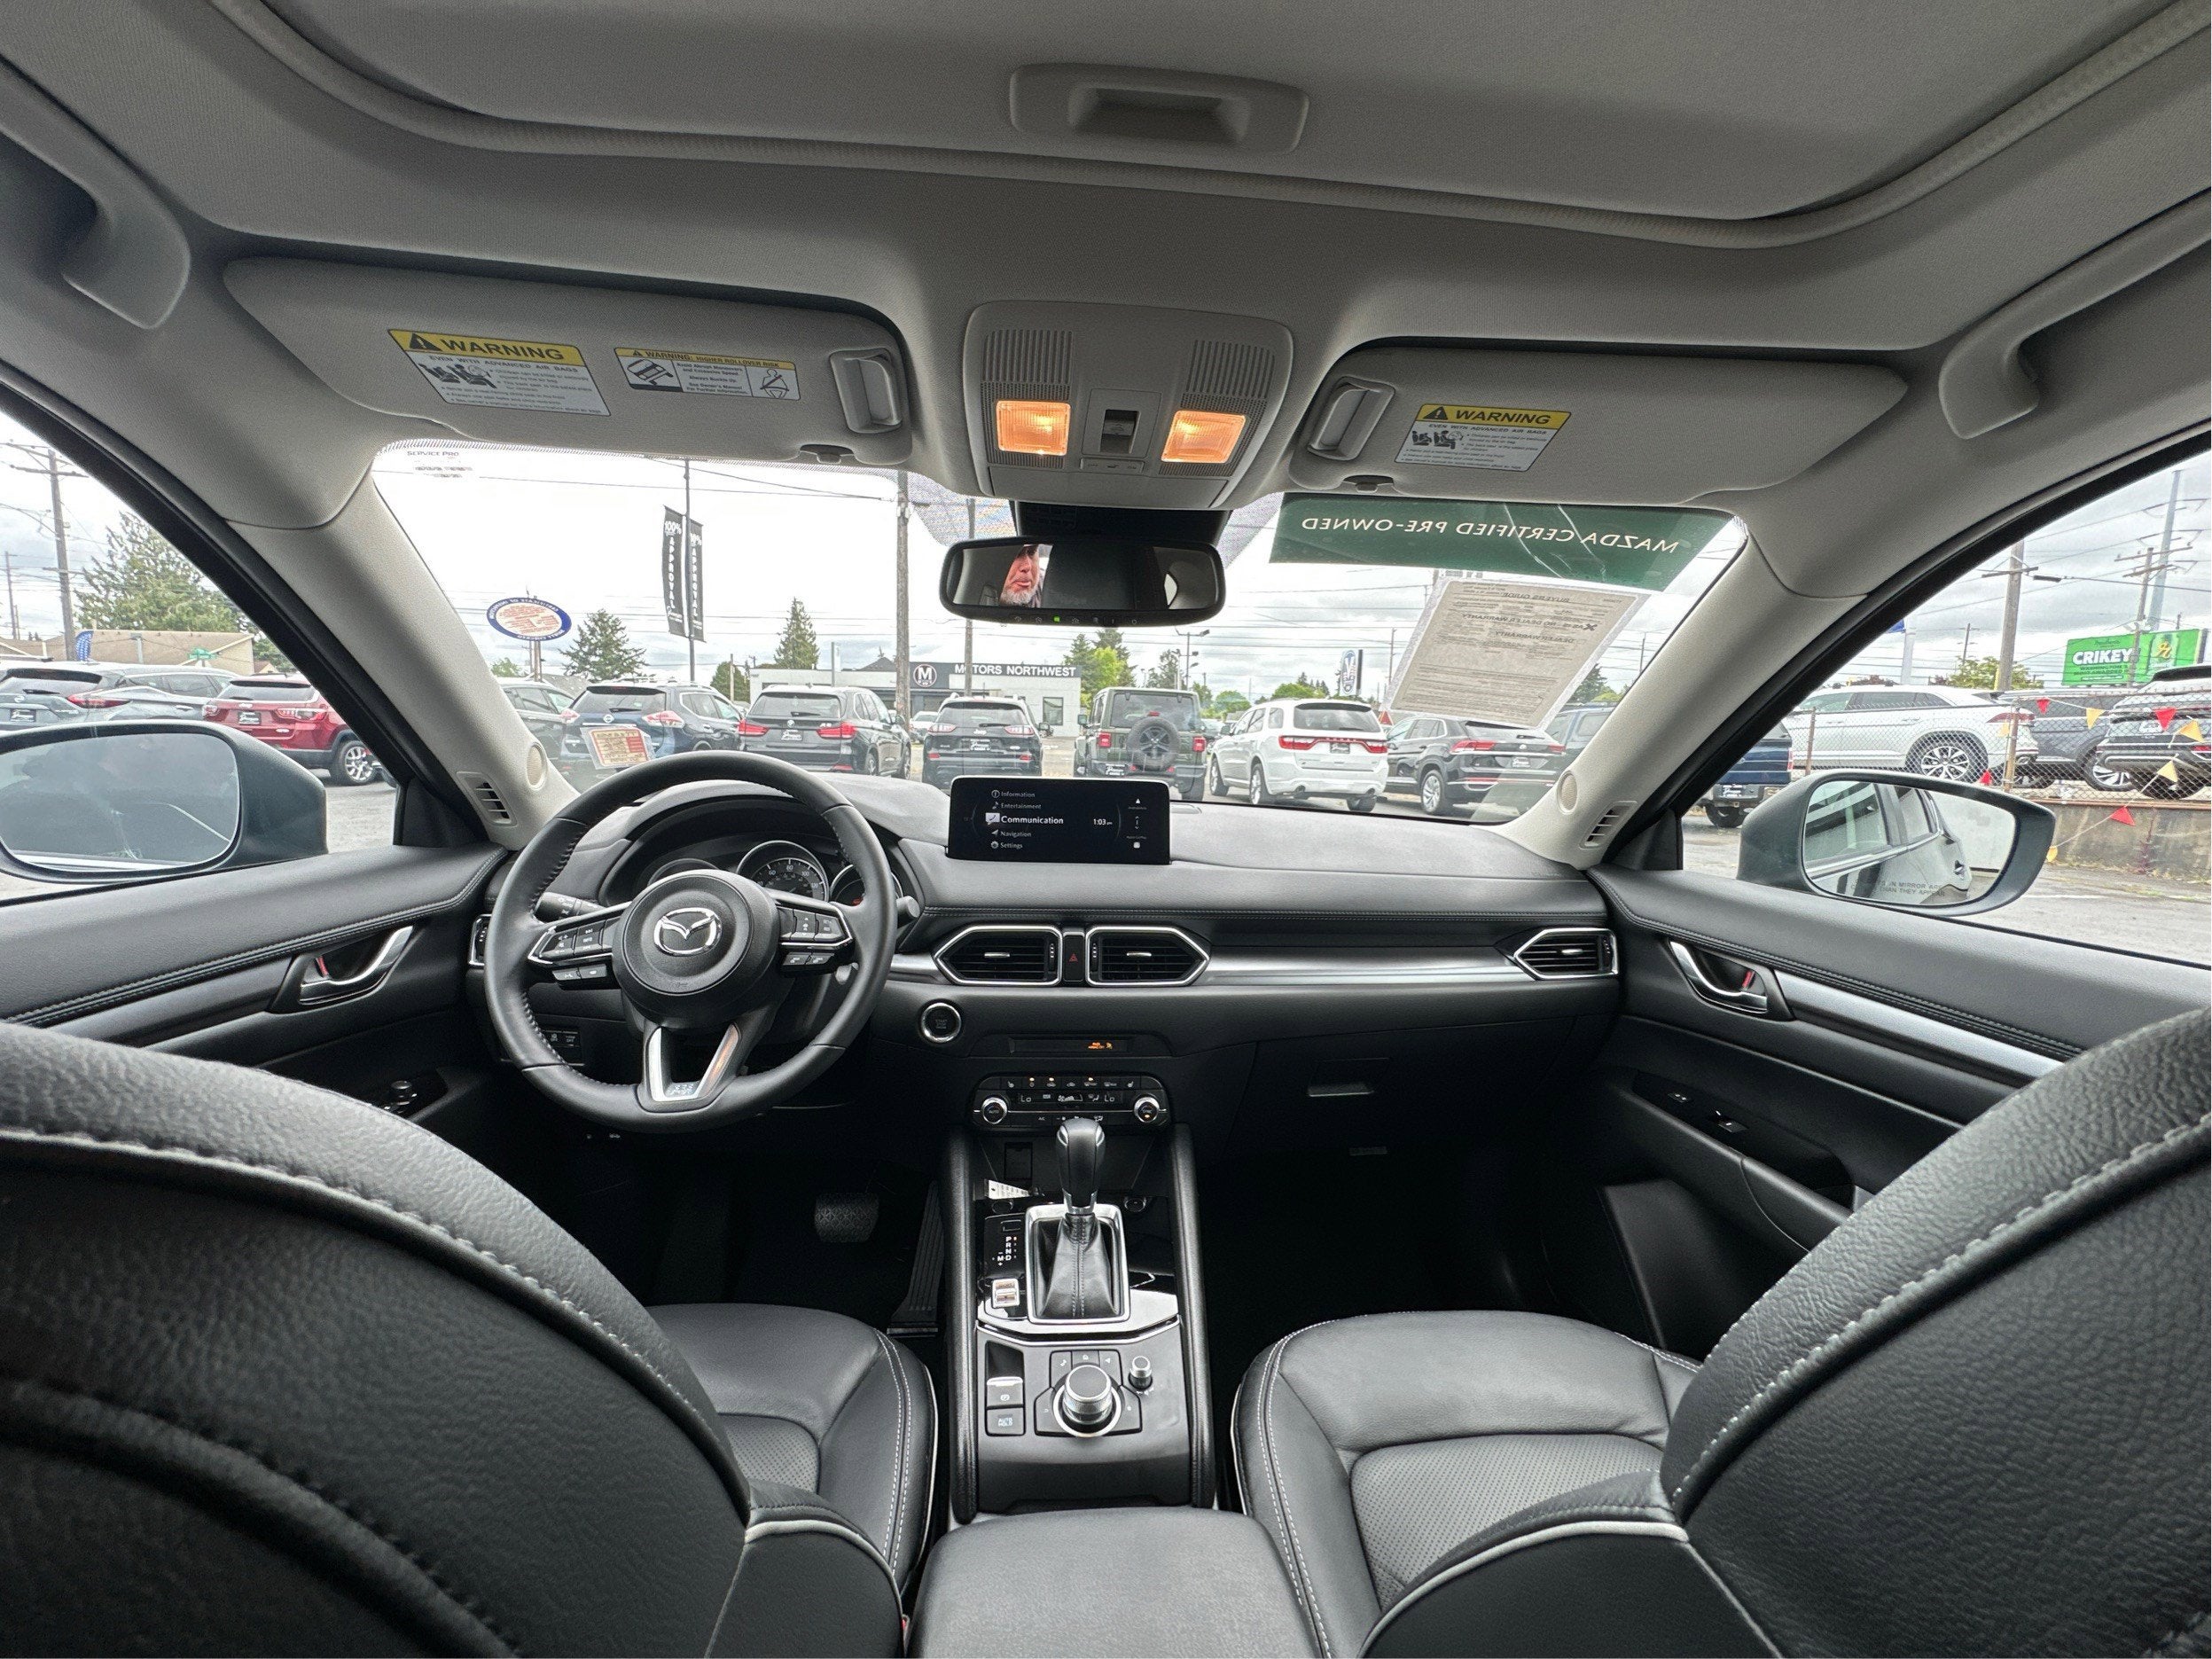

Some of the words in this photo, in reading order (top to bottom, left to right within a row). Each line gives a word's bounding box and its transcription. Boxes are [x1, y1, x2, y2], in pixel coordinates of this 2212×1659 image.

[440, 339, 564, 360] WARNING
[484, 360, 531, 369] ADVANCED
[1455, 410, 1552, 425] WARNING
[2072, 648, 2133, 665] CRIKEY
[918, 667, 932, 680] M
[955, 664, 1002, 675] MTORS
[1006, 666, 1076, 677] NORTHWEST
